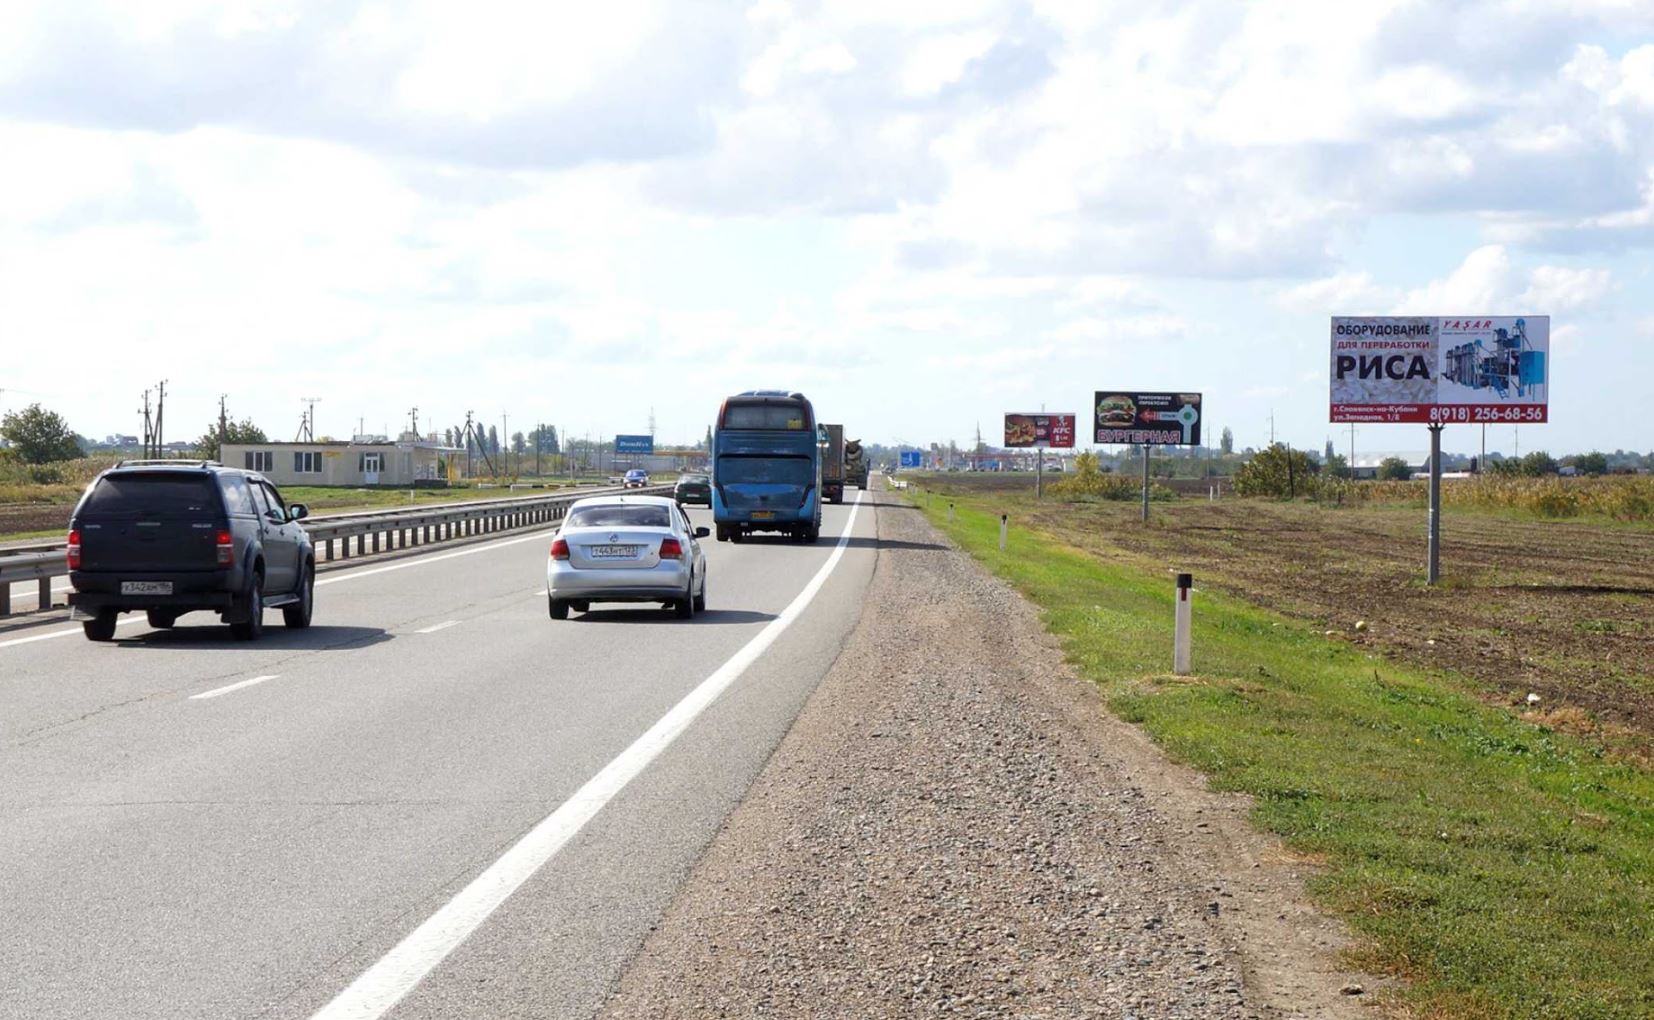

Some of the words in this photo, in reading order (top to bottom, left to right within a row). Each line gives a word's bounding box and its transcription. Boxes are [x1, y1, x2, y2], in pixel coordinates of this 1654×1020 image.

[1336, 324, 1431, 336] ОБОРУДОВАНИЕ
[1443, 320, 1492, 331] YAŞAR
[1336, 341, 1358, 350] ДЛЯ
[1360, 341, 1431, 349] ПЕРЕРАБОТКИ
[1336, 355, 1431, 381] РИСА
[1429, 407, 1471, 422] 8(918)
[1474, 407, 1543, 420] 256-68-56
[1052, 426, 1071, 434] KFC
[1097, 429, 1181, 443] БУРГЕРНАЯ
